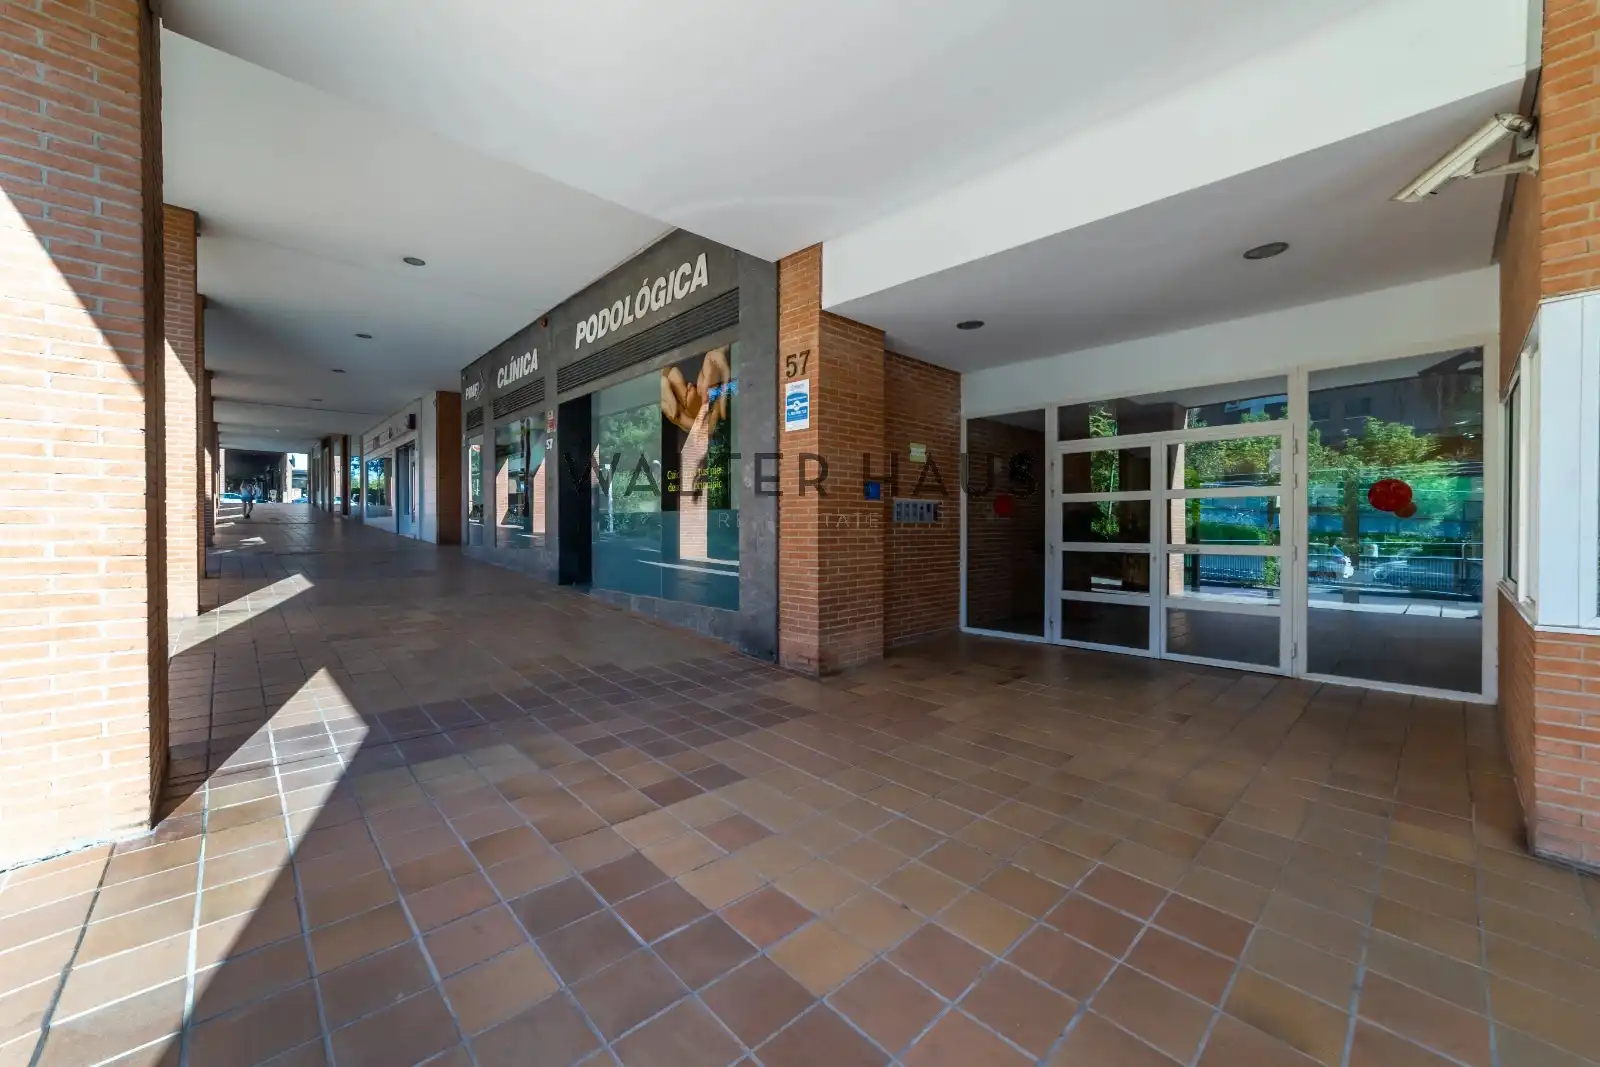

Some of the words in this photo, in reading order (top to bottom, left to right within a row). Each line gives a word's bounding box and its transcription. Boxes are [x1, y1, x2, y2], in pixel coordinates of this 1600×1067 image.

[575, 252, 709, 350] PODOLÓGICA
[497, 348, 538, 389] CLÍNICA
[785, 349, 811, 378] 57
[546, 438, 554, 450] 57
